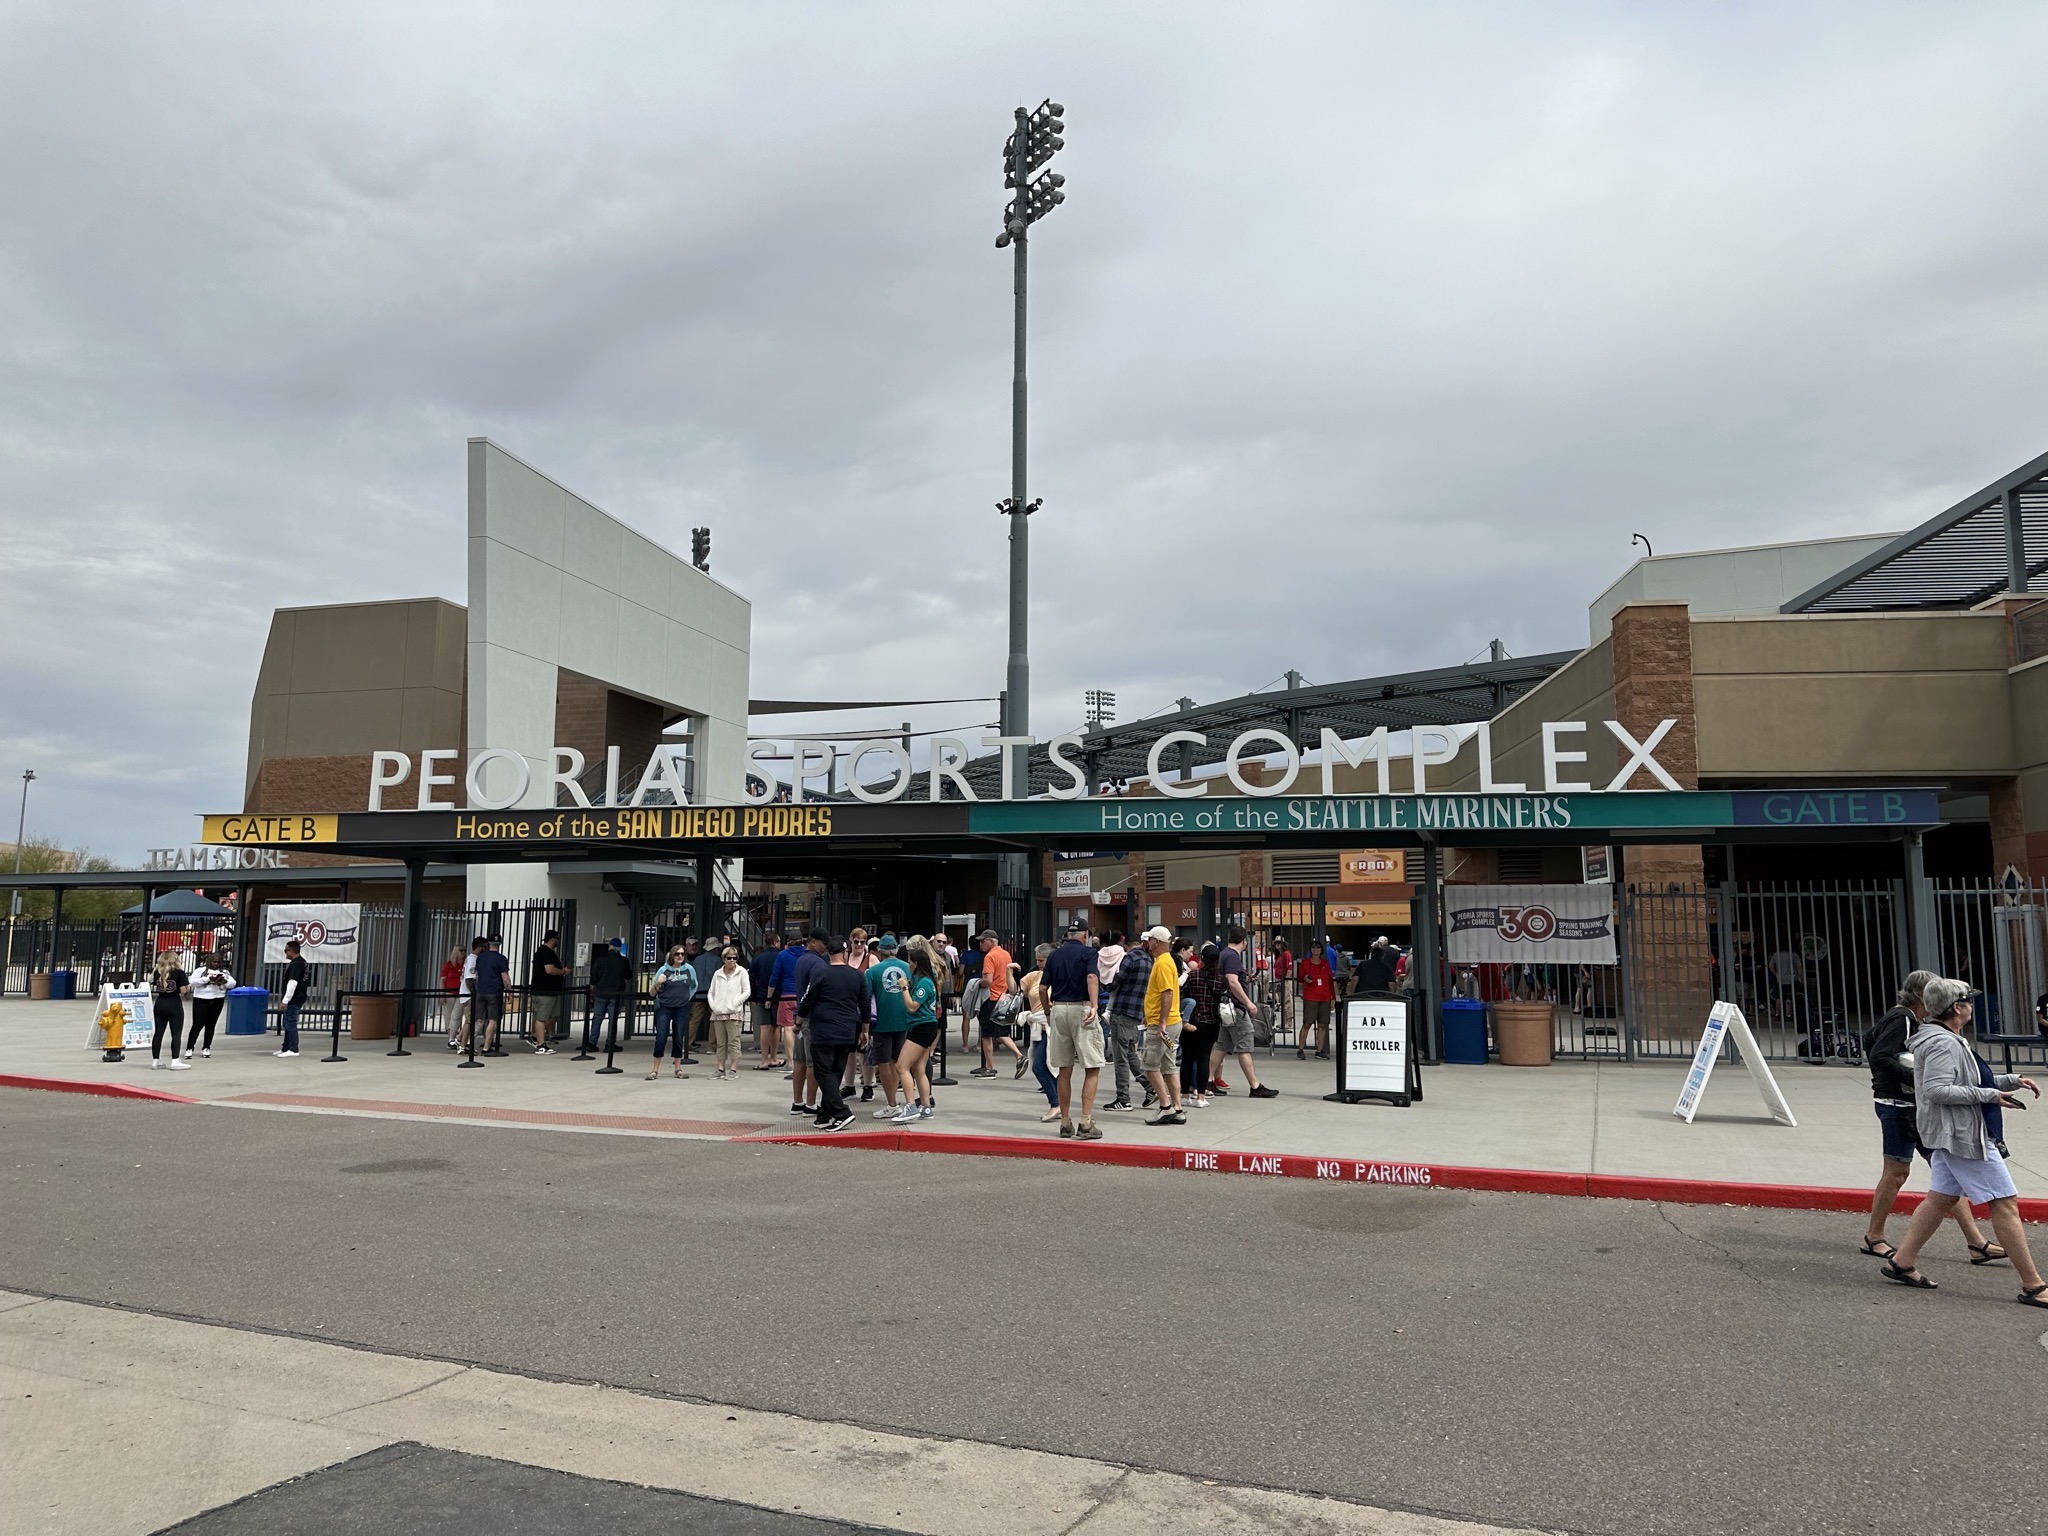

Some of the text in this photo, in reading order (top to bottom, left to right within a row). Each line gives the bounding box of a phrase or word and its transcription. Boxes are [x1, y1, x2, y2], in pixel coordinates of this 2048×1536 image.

[368, 718, 1685, 812] PEORIA SPORTS COMPLEX
[1101, 796, 1571, 830] Home of the SEATTLE MARINERS
[1763, 793, 1907, 824] GATE B
[222, 817, 317, 842] GATE B
[456, 806, 832, 839] Home of the SAN DIEGO PADRES
[147, 846, 290, 871] TEAM STORE
[1457, 911, 1495, 920] PEORIA SPORTS
[1471, 918, 1496, 926] COMPLEX
[1497, 905, 1557, 943] 30
[1558, 919, 1603, 930] SPRING TRAINING
[293, 920, 327, 948] 30
[1558, 929, 1583, 937] SEASONS
[1362, 1016, 1386, 1027] ADA
[1352, 1040, 1400, 1051] STROLLER
[1185, 1152, 1432, 1185] FIRE LANE NO PARKING
